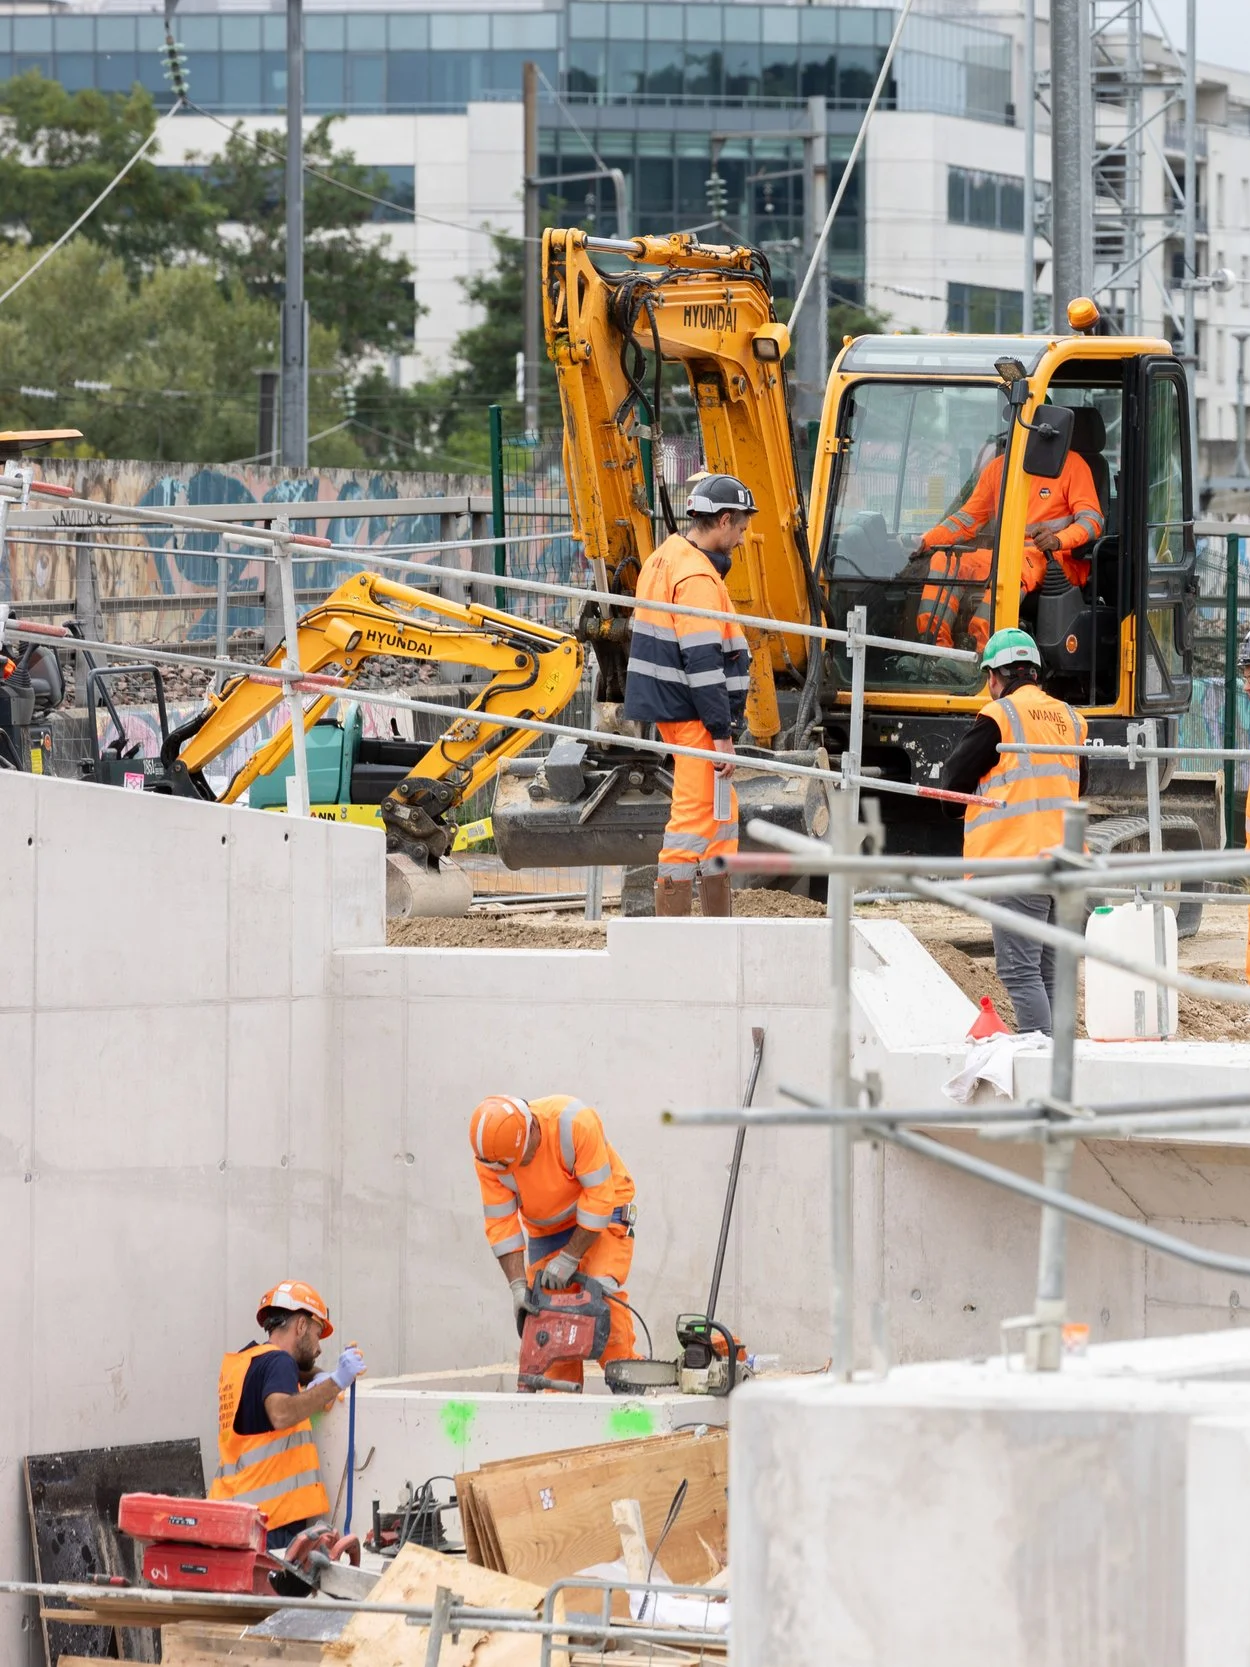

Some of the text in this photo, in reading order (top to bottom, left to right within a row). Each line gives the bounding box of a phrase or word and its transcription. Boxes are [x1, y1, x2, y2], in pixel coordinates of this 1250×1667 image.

[683, 303, 737, 333] HYUNDAI
[366, 629, 433, 656] HYUNDAI
[1028, 709, 1065, 723] WIAME
[1055, 723, 1067, 736] TP
